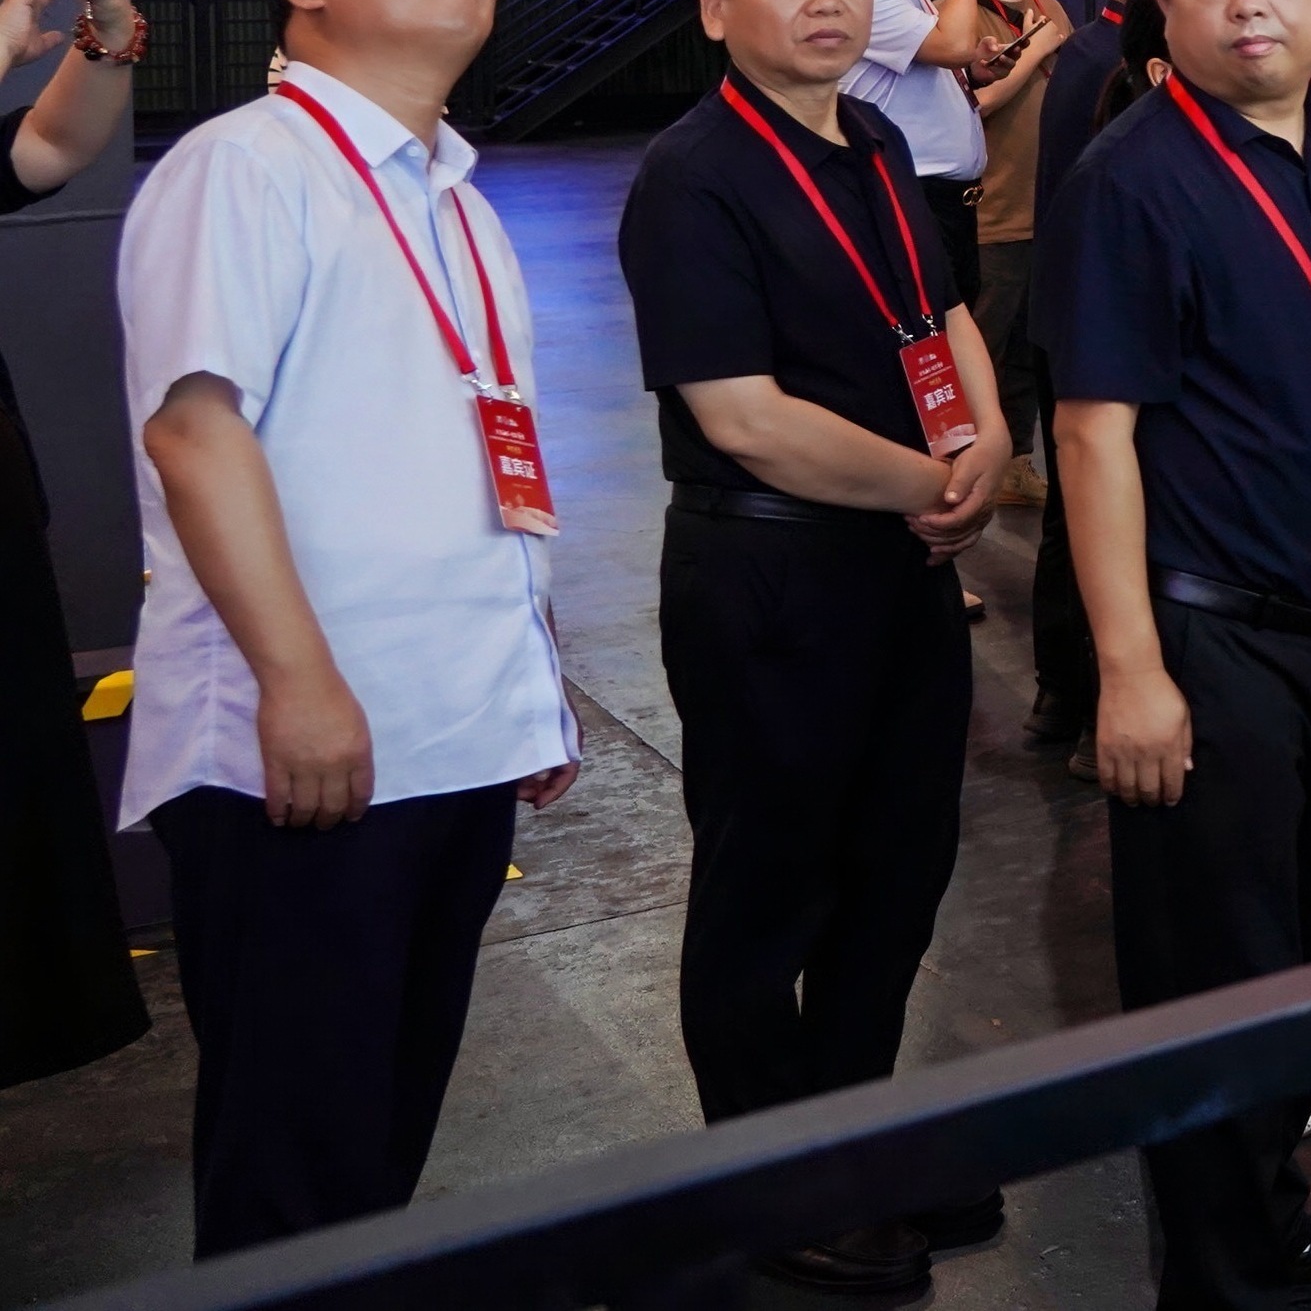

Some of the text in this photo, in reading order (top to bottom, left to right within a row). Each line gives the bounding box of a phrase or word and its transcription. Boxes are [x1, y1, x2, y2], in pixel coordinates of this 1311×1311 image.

[924, 383, 956, 411] 嘉宾证
[498, 455, 538, 480] 嘉宾证
